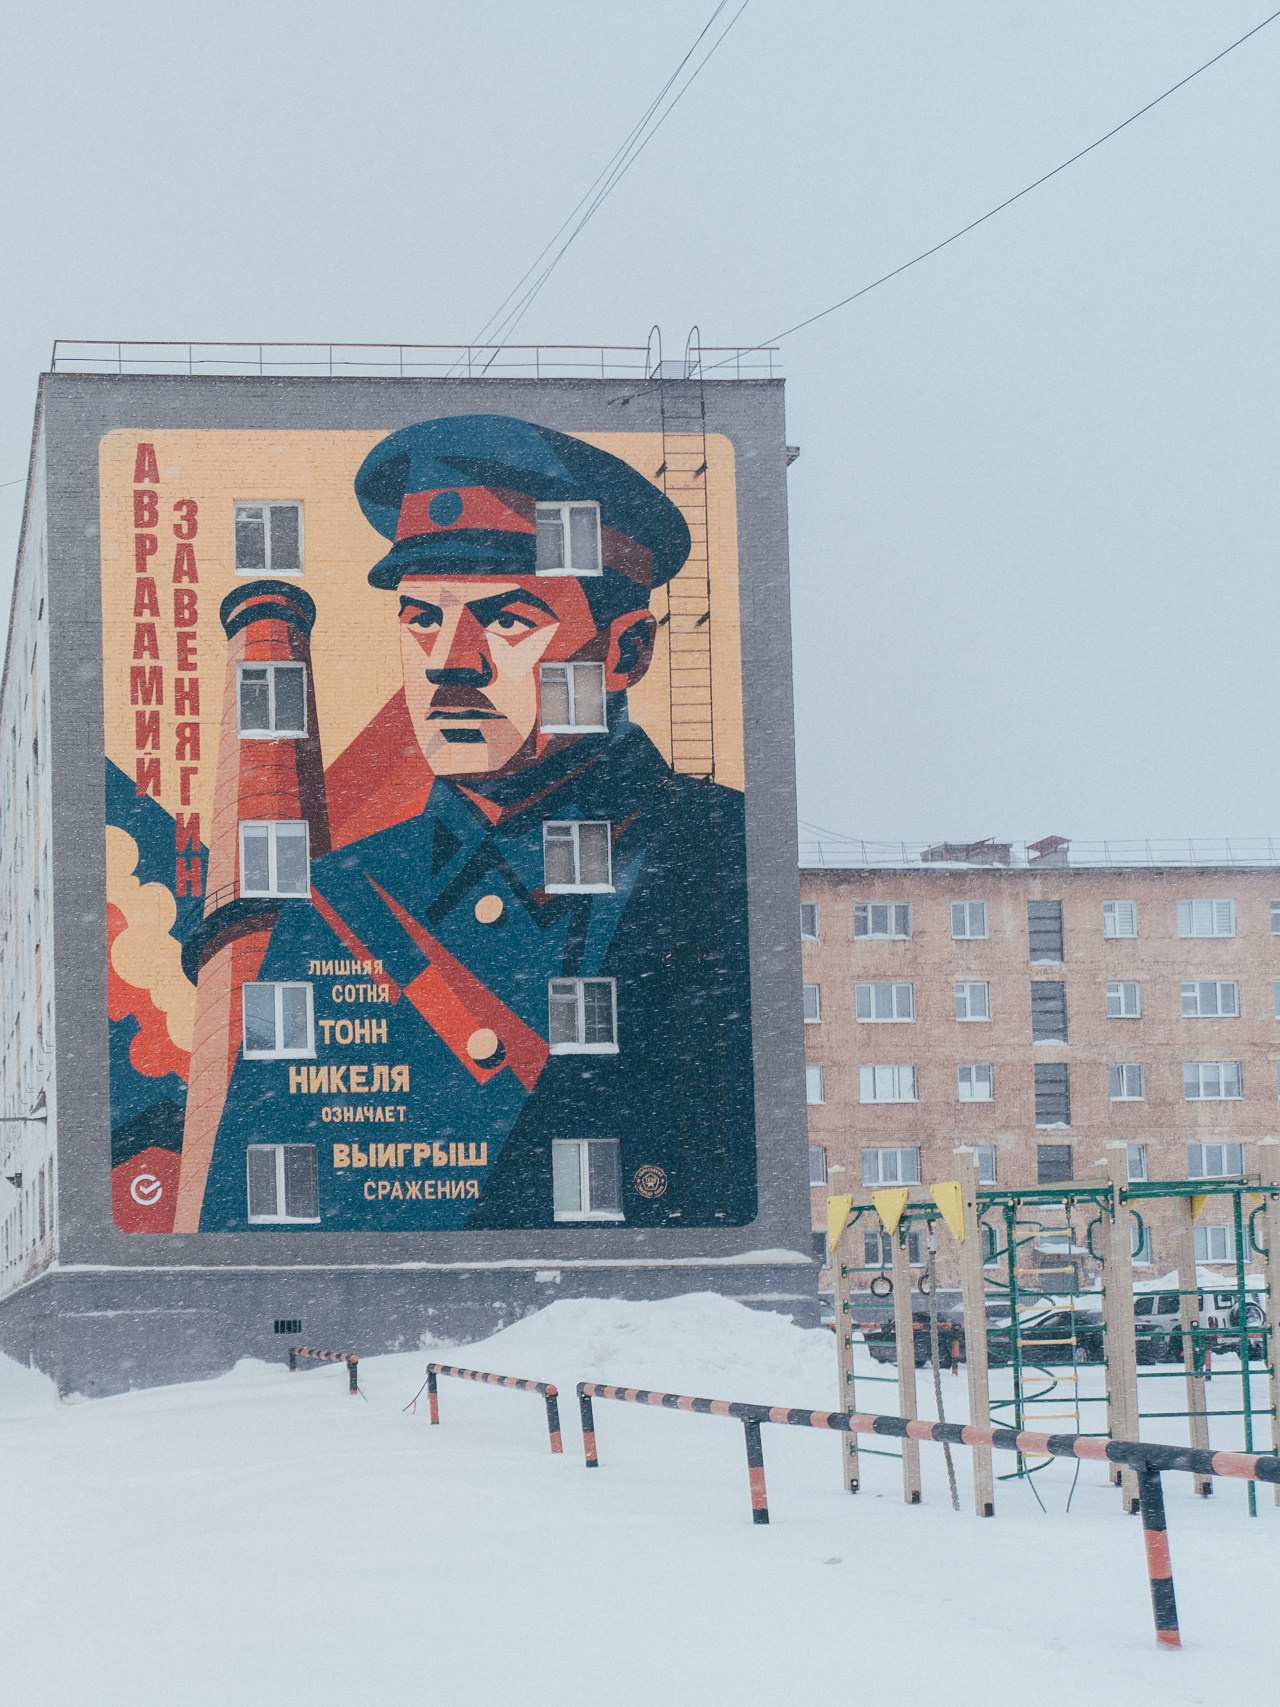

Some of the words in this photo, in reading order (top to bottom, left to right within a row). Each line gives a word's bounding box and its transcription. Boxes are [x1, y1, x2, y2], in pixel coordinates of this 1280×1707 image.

[130, 443, 164, 797] АВРААМИЙ
[172, 499, 202, 897] ЗАВЕНЯГИН
[308, 959, 384, 976] ЛИШНЯЯ
[331, 983, 390, 1003] СОТНЯ
[318, 1018, 388, 1045] ТОНН
[289, 1065, 411, 1094] НИКЕЛЯ
[321, 1106, 407, 1123] ОЗНАЧАЕТ
[332, 1142, 488, 1168] ВЫИГРЫШ
[363, 1179, 480, 1200] СРАЖЕНИЯ
